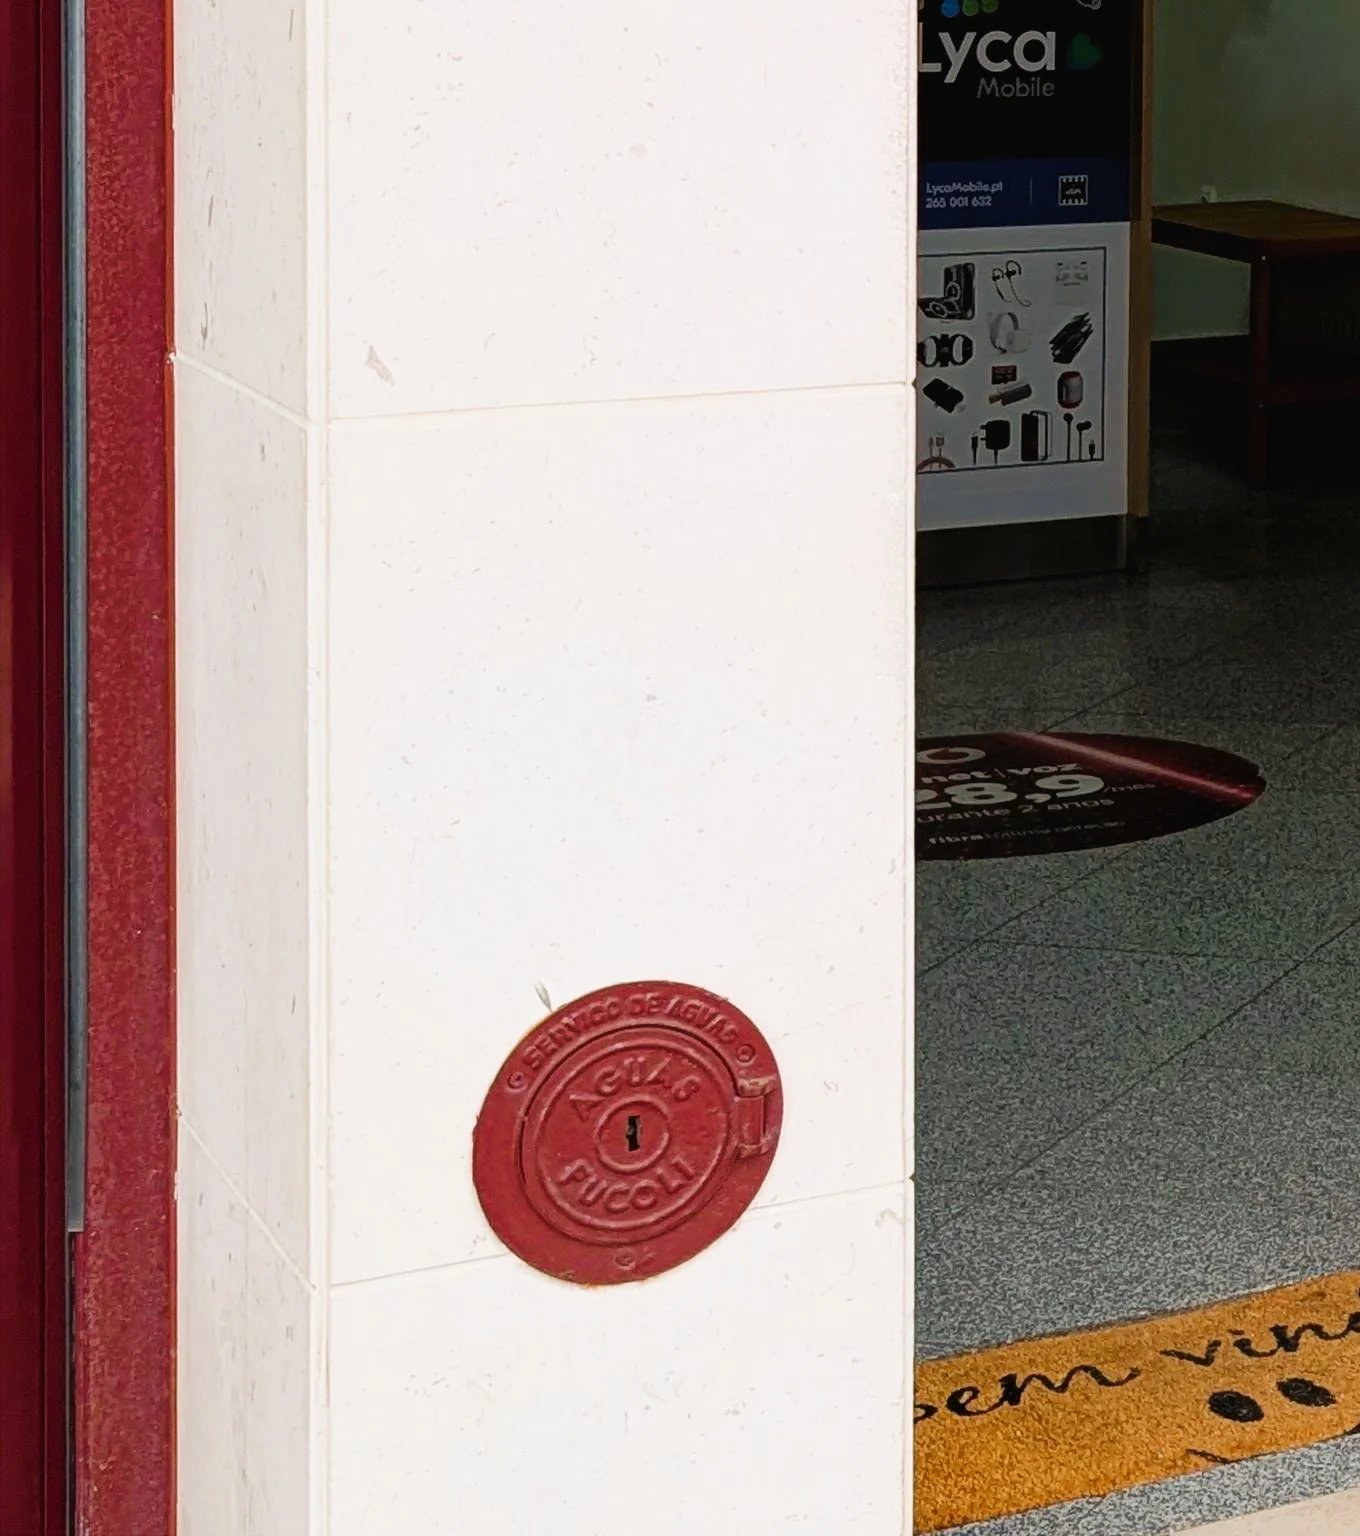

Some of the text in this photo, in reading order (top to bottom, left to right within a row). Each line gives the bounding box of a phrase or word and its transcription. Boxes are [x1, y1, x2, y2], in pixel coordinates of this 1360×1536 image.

[919, 22, 1056, 84] Lyca
[976, 77, 1056, 98] Mobile
[916, 806, 1010, 824] urante
